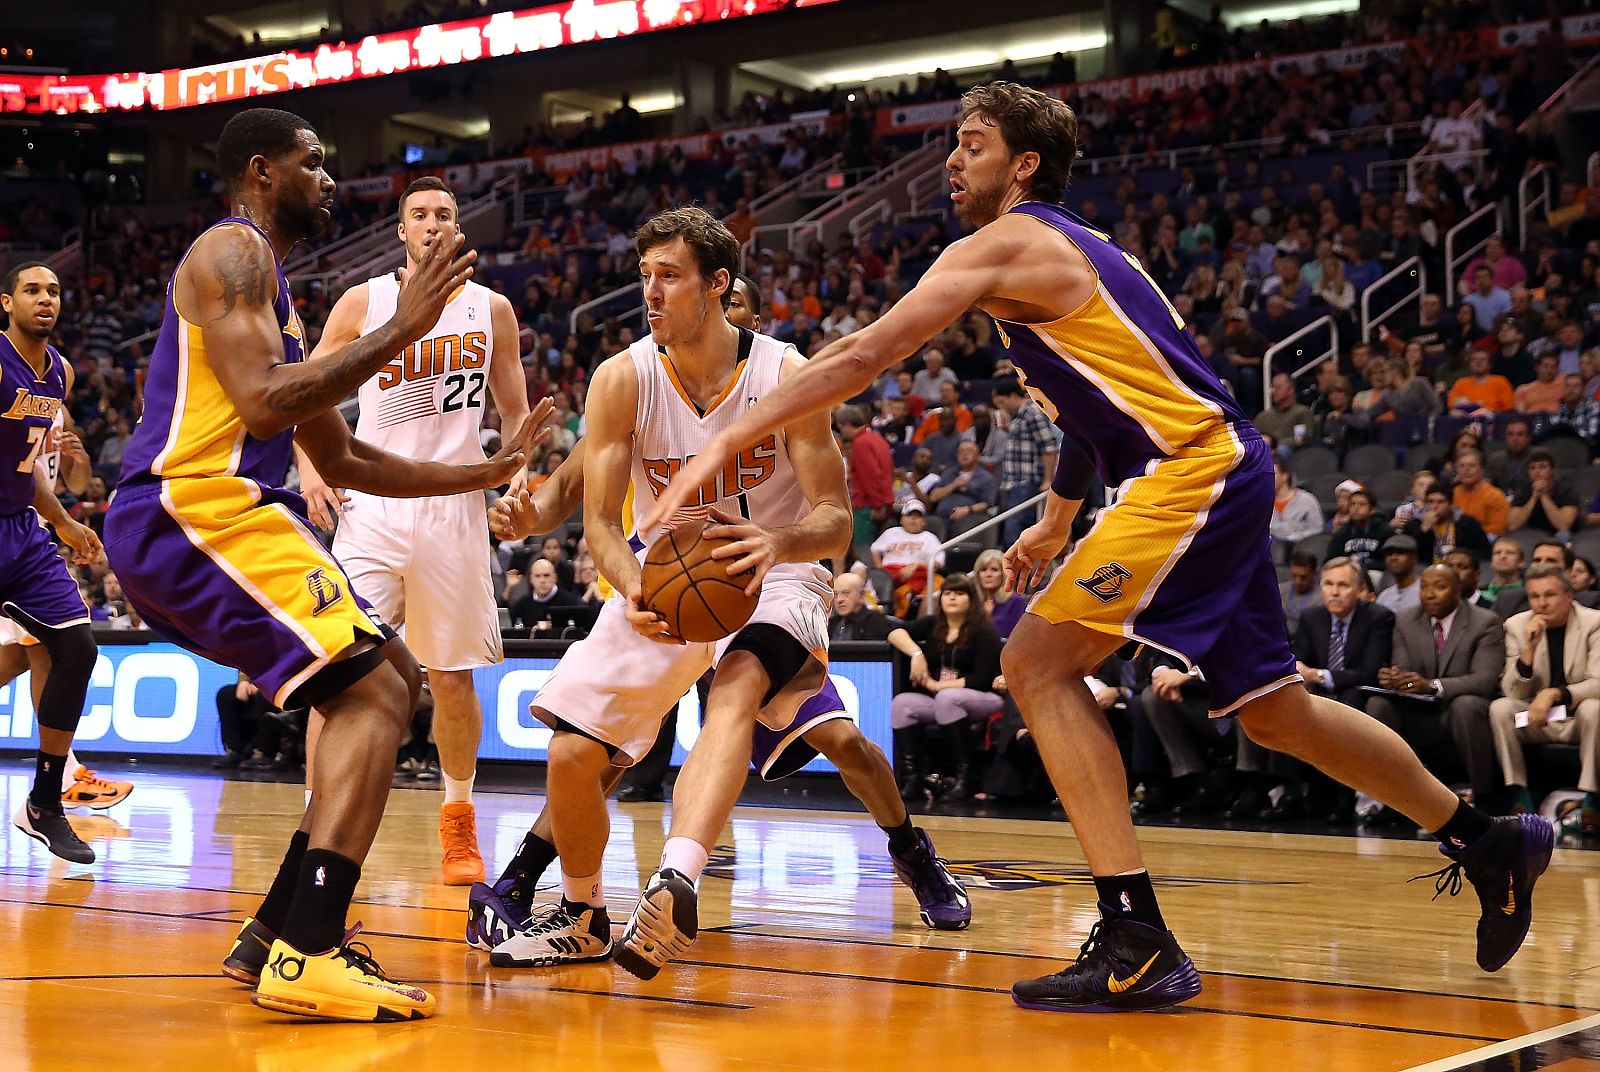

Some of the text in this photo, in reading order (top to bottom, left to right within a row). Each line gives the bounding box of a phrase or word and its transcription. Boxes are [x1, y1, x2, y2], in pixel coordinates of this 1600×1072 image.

[378, 331, 487, 391] SUNS
[442, 372, 485, 414] 22
[16, 426, 47, 474] 7
